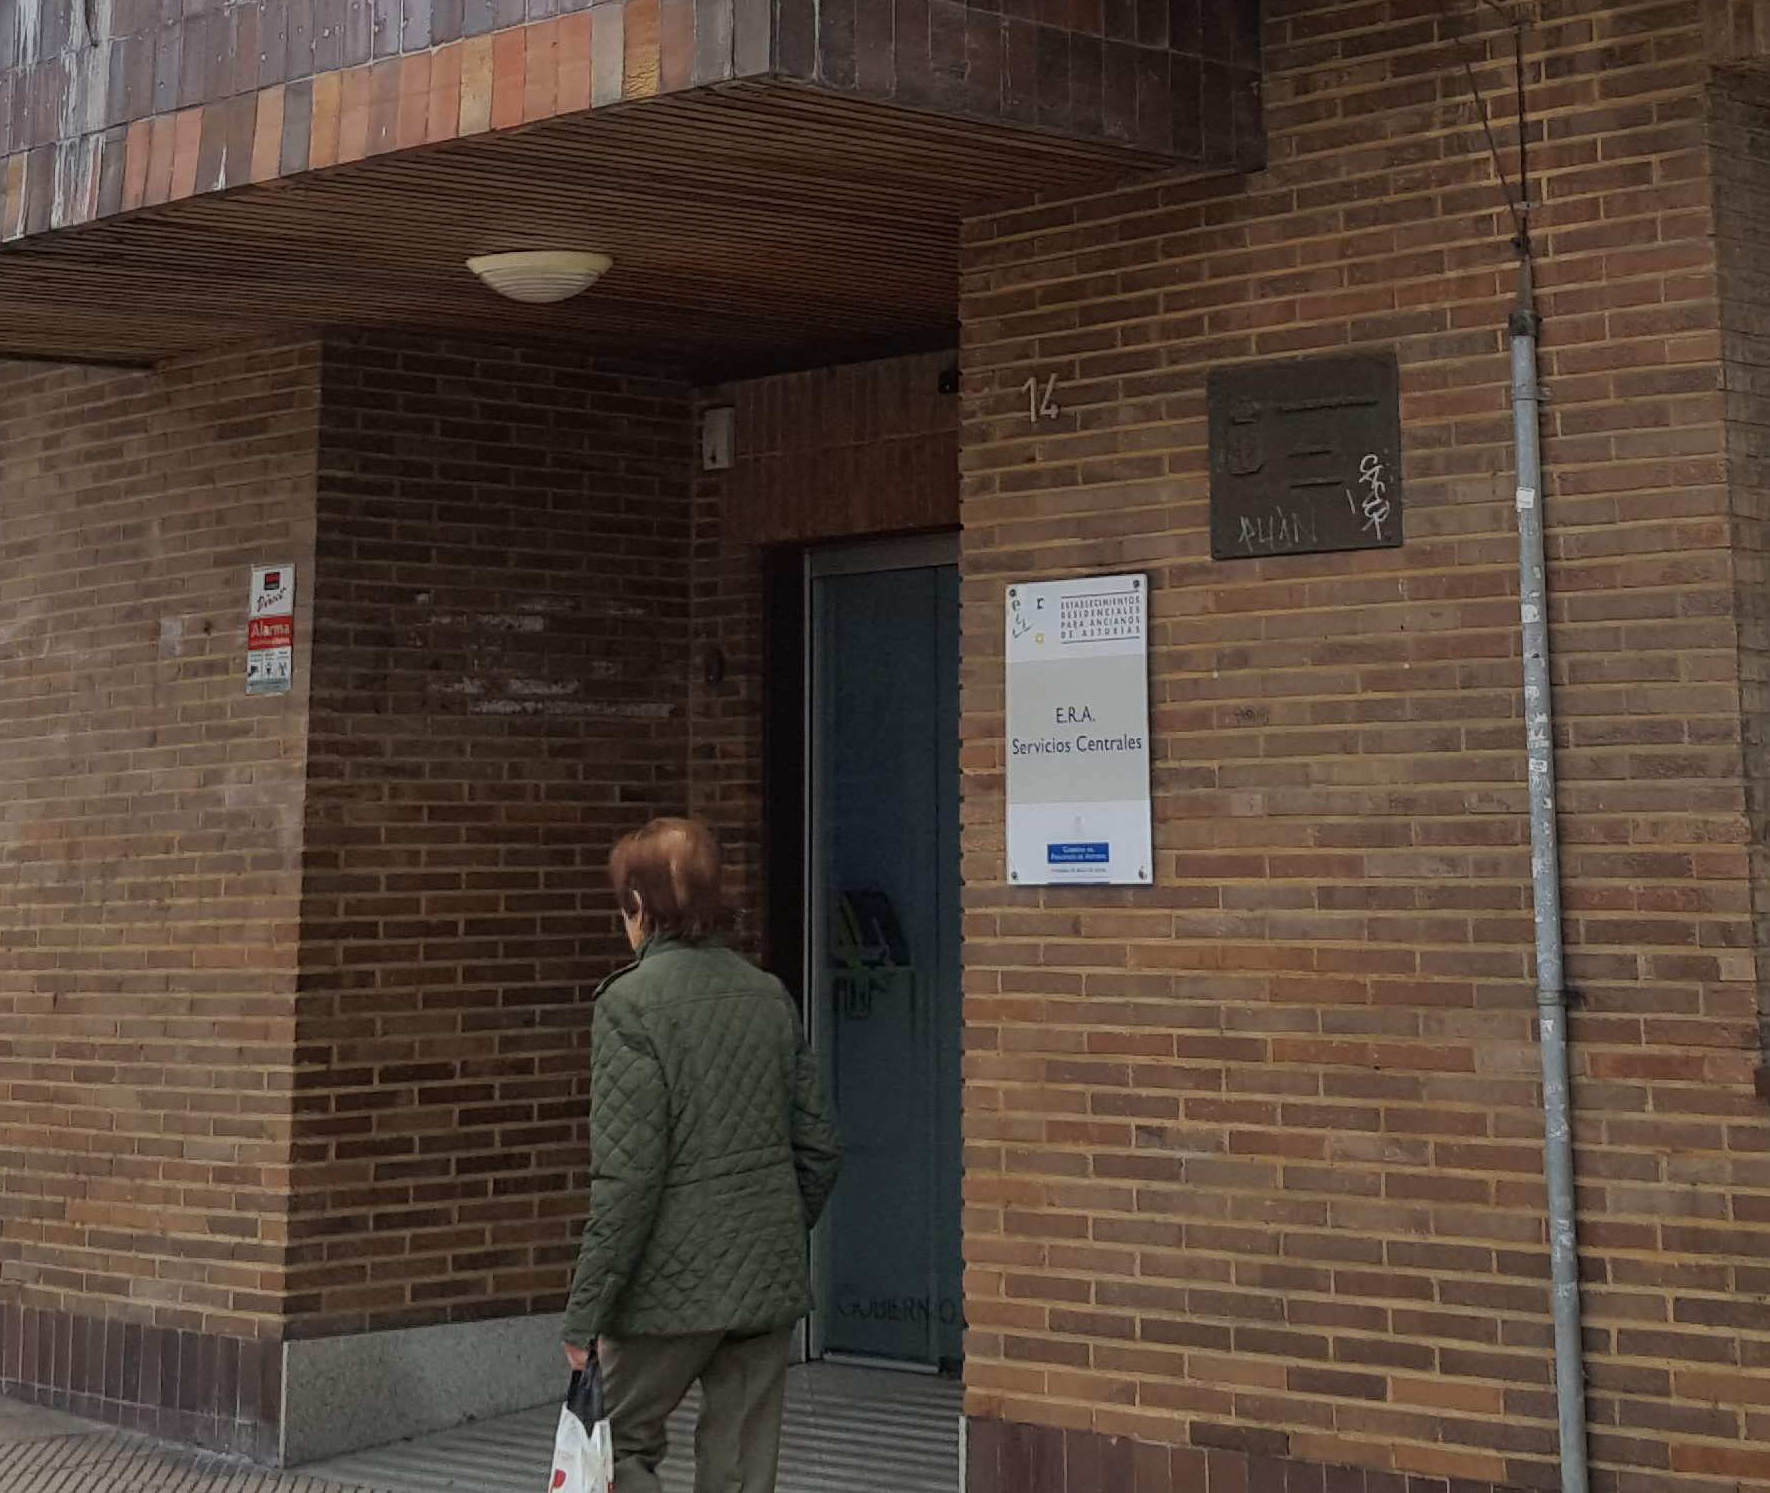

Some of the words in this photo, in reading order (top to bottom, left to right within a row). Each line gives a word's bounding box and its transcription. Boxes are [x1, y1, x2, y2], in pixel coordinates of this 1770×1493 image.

[1021, 373, 1059, 423] 14
[1060, 595, 1140, 610] ESTABLECIMIENTOS
[1060, 606, 1140, 619] RESIDENCIALES
[250, 619, 290, 638] Alarma
[1060, 618, 1084, 629] PARA
[1090, 615, 1140, 627] ANCIANOS
[1060, 629, 1074, 639] DE
[1082, 625, 1140, 637] ASTURIAS
[1055, 705, 1096, 724] E.R.A.
[1012, 737, 1071, 755] Servicios
[1076, 733, 1142, 753] Centrales
